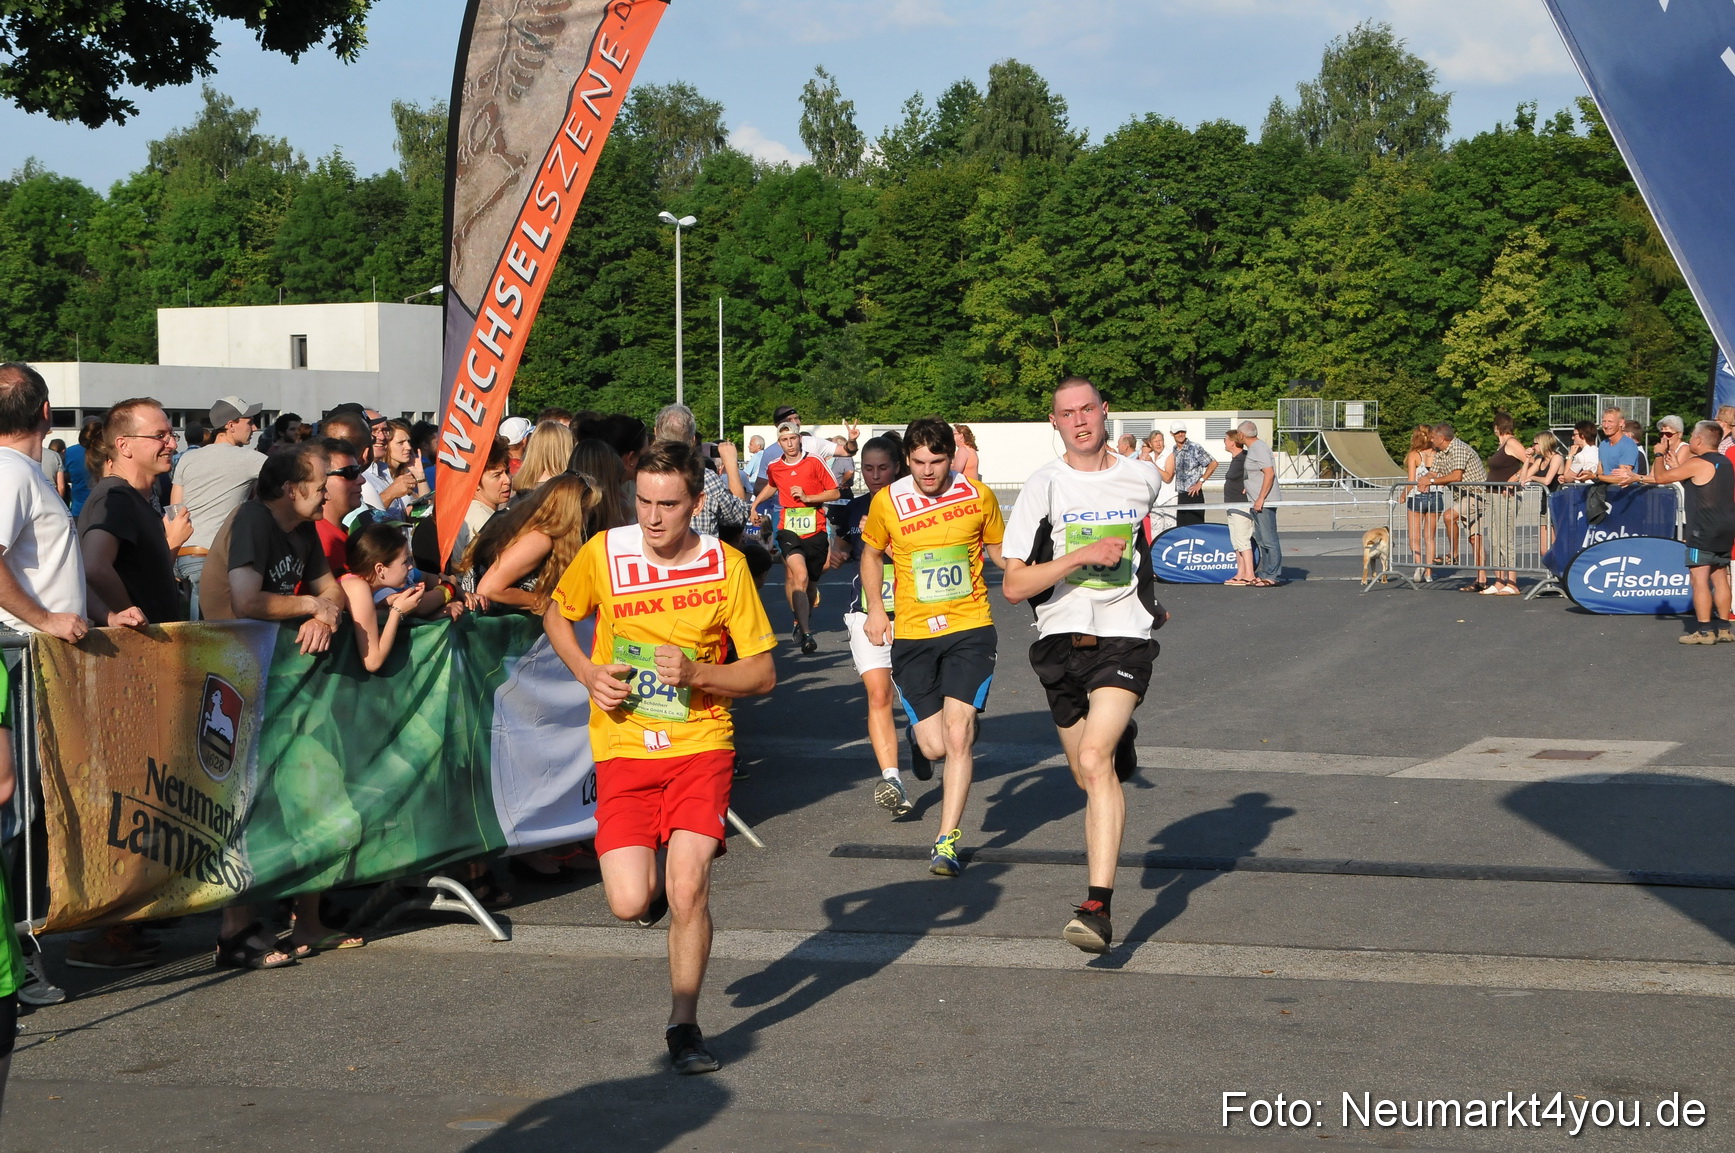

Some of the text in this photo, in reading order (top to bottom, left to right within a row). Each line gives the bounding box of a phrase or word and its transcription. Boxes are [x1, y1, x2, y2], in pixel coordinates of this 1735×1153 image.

[438, 0, 635, 472] WECHSELSZENE.D
[790, 517, 811, 529] 110
[901, 516, 939, 536] MAX
[943, 504, 982, 522] BÖGL
[1063, 509, 1137, 523] DELPHI
[1177, 549, 1237, 565] Fische
[921, 565, 963, 590] 760
[613, 588, 728, 619] MAX BÖGL
[1612, 588, 1689, 598] AUTOMOBILE
[206, 750, 225, 773] 1628
[583, 769, 598, 806] La
